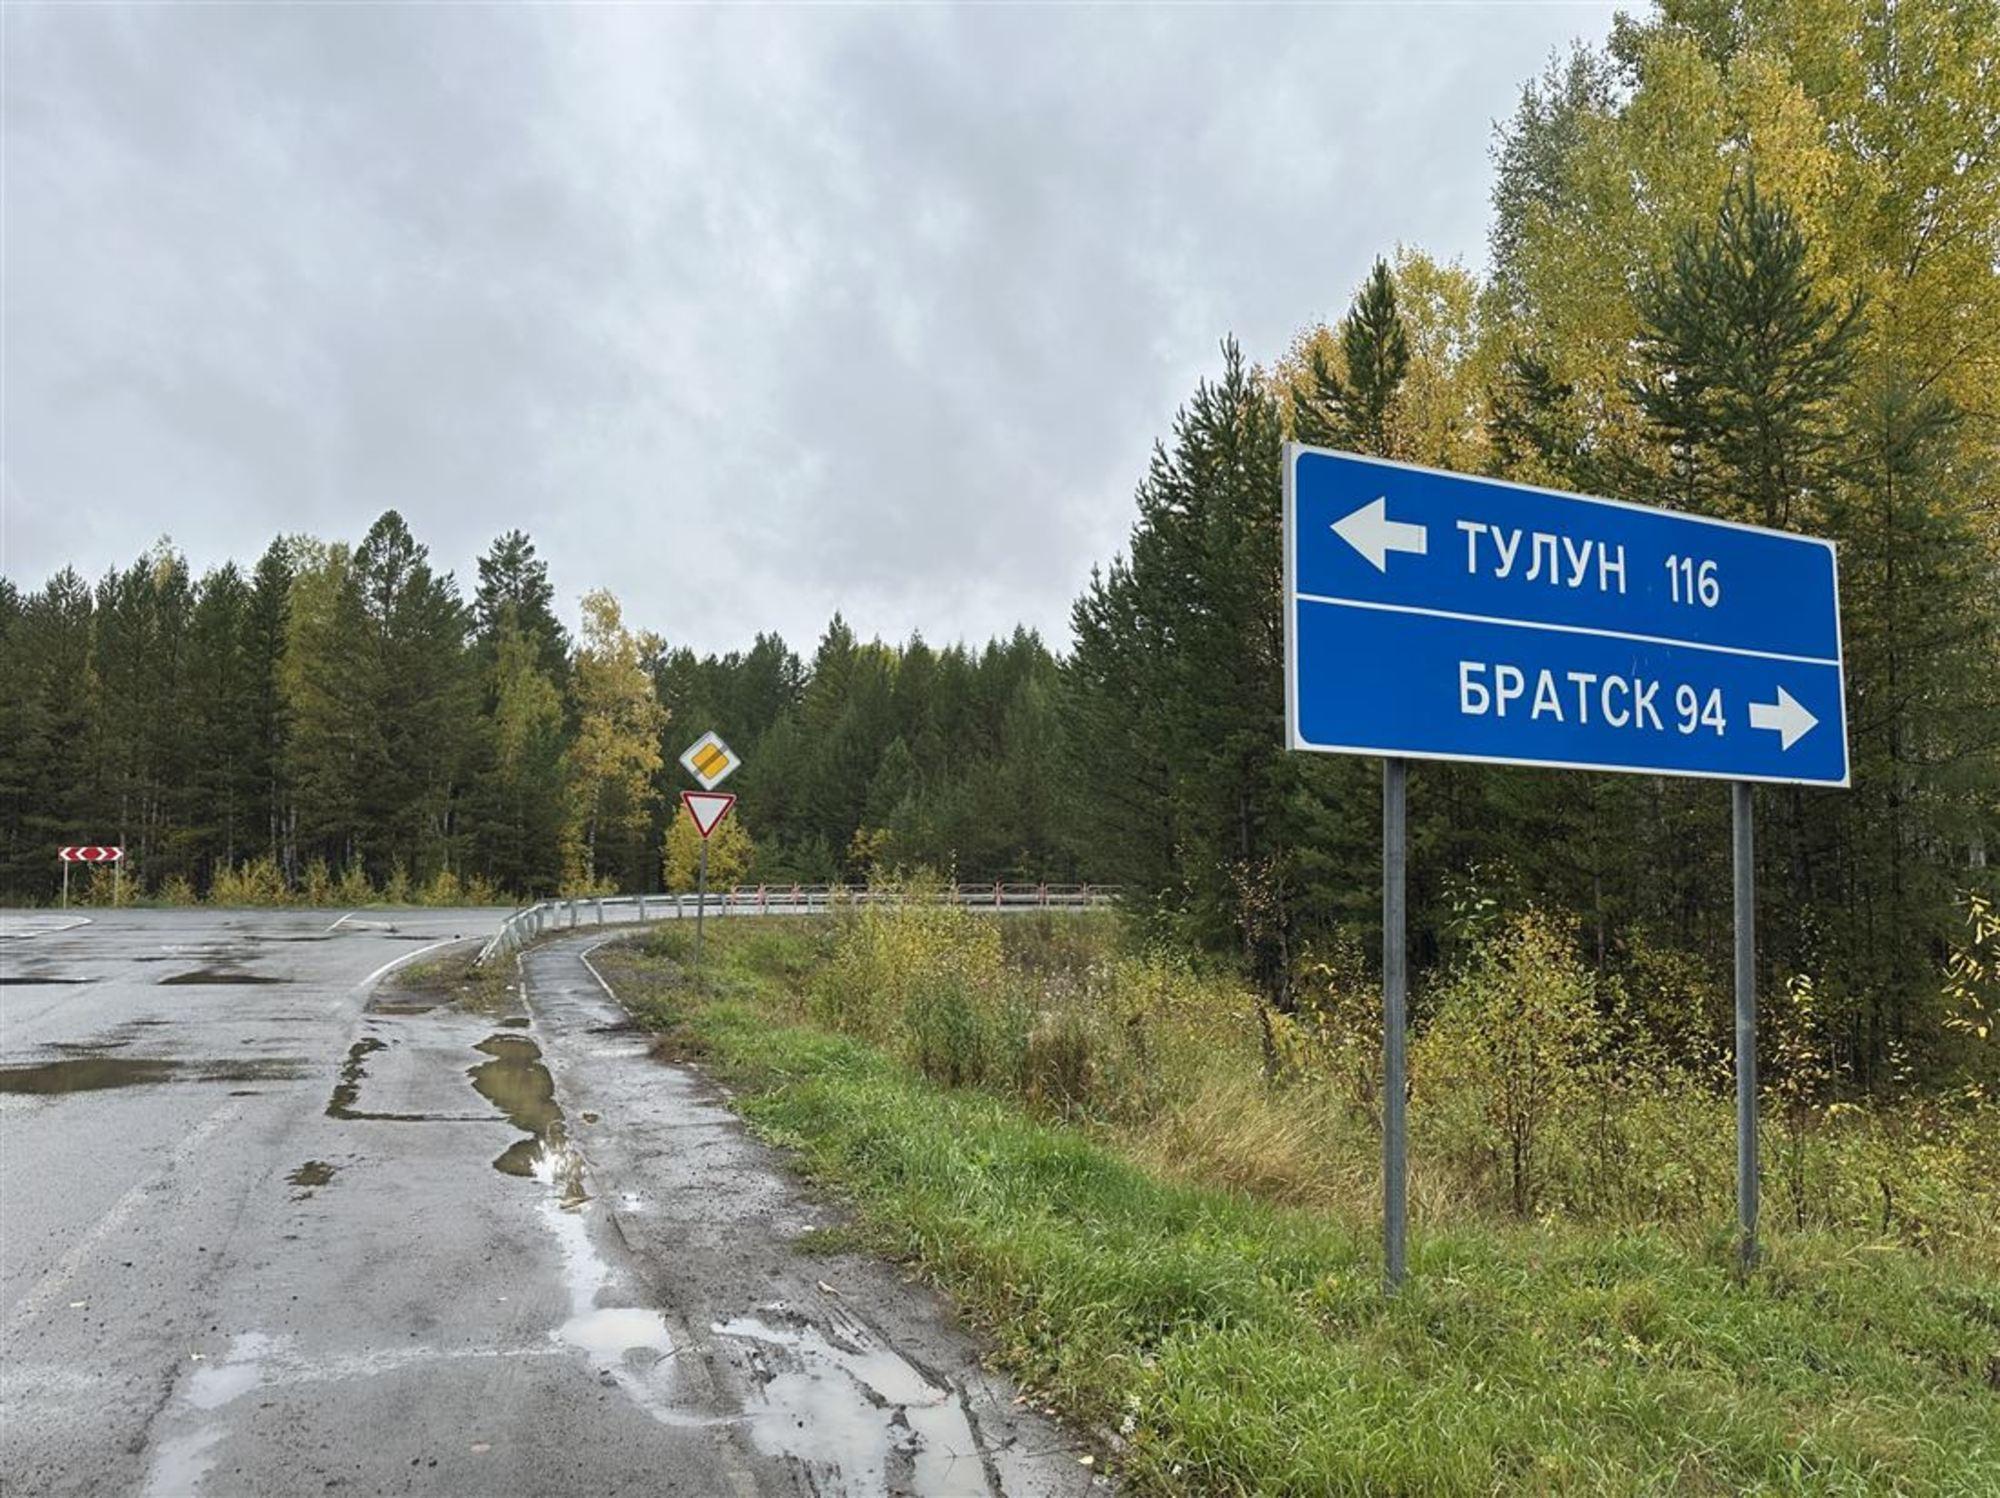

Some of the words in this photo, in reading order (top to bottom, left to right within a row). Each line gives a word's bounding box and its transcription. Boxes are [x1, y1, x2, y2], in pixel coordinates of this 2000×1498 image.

[1456, 520, 1626, 594] ТУЛУН
[1665, 555, 1720, 608] 116
[1459, 661, 1664, 731] БРАТСК
[1676, 684, 1726, 736] 94
